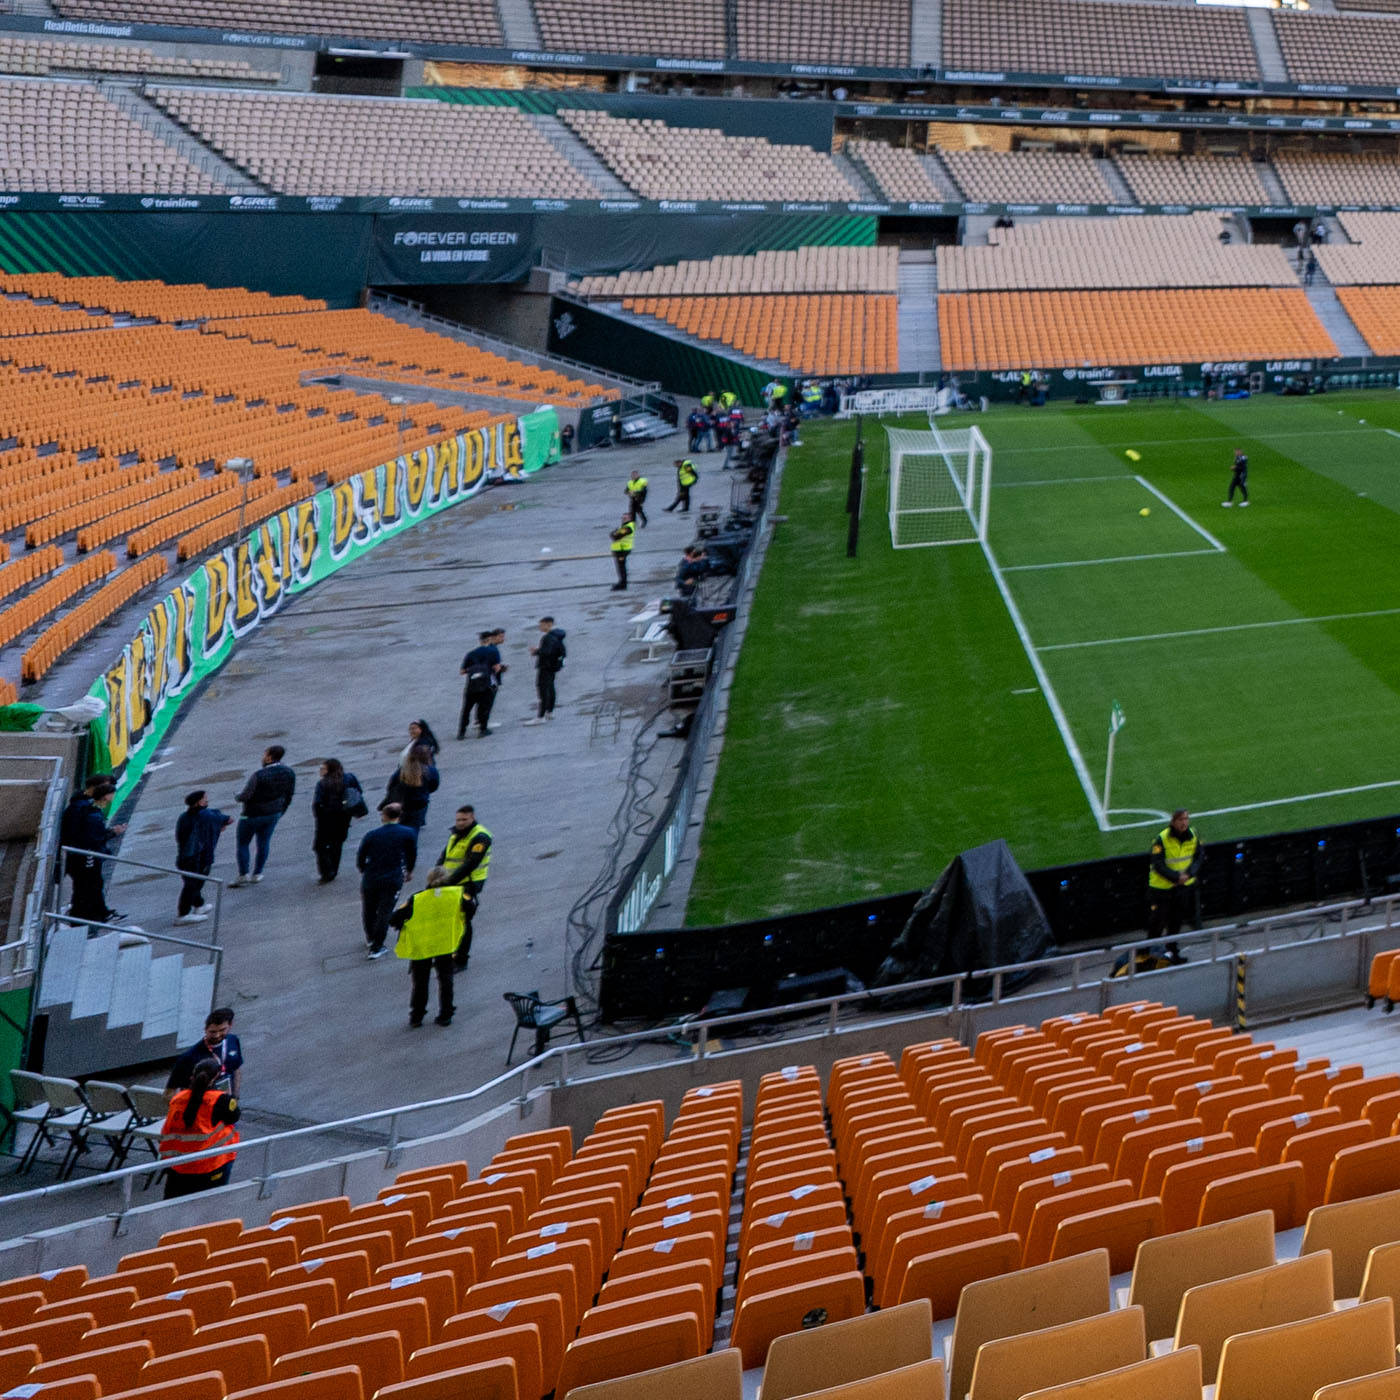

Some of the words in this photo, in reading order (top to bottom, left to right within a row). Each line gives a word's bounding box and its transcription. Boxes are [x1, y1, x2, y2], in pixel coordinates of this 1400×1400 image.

[44, 20, 64, 30] Real
[223, 34, 270, 44] FOREVER
[272, 37, 305, 46] GREEN
[58, 195, 105, 204] REVEL
[155, 198, 200, 208] trainline
[243, 197, 278, 206] GREE
[471, 200, 509, 208] trainline
[394, 232, 467, 246] FOREVER
[470, 232, 517, 245] GREEN
[420, 250, 432, 262] LA
[1144, 365, 1182, 378] LALIGA
